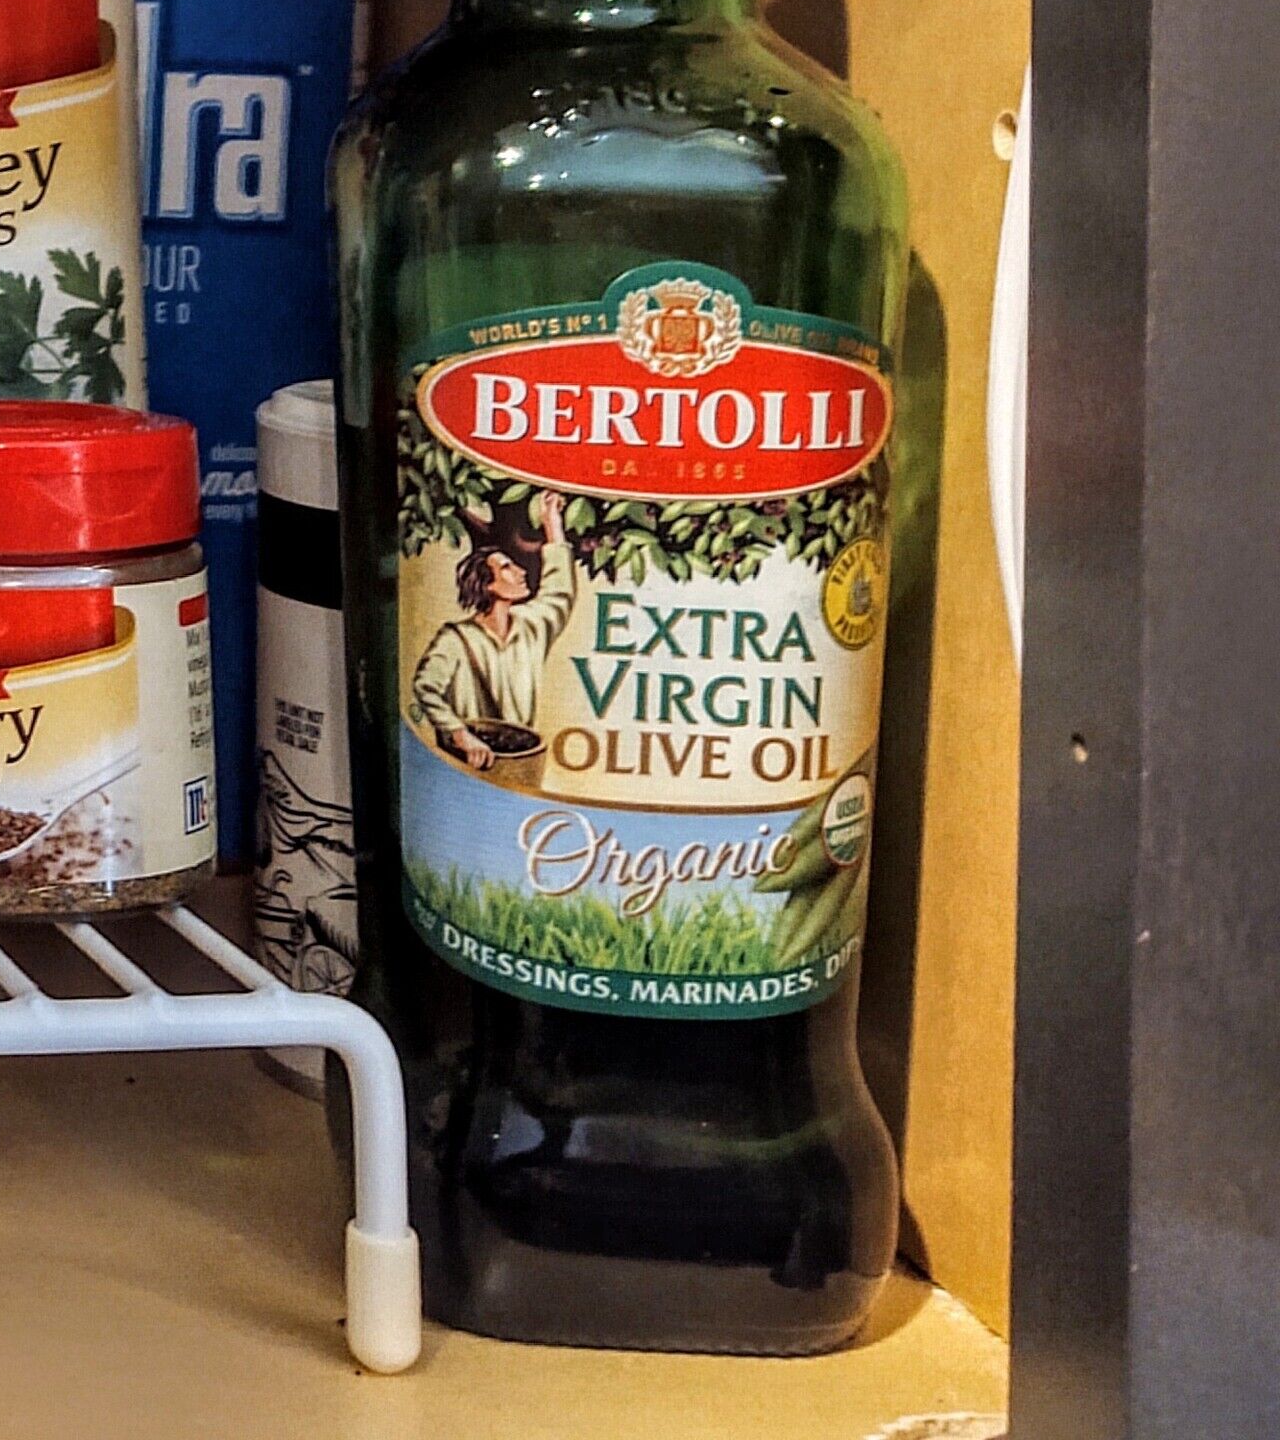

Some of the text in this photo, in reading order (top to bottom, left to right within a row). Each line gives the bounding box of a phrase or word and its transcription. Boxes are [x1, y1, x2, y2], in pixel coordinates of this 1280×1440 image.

[470, 317, 560, 345] WORLD'S
[597, 313, 608, 330] 1
[470, 372, 867, 451] BERTOLLI
[594, 592, 816, 663] EXTRA
[572, 657, 822, 729] VIRGIN
[552, 727, 837, 784] OLIVE OIL
[517, 809, 799, 918] Organic
